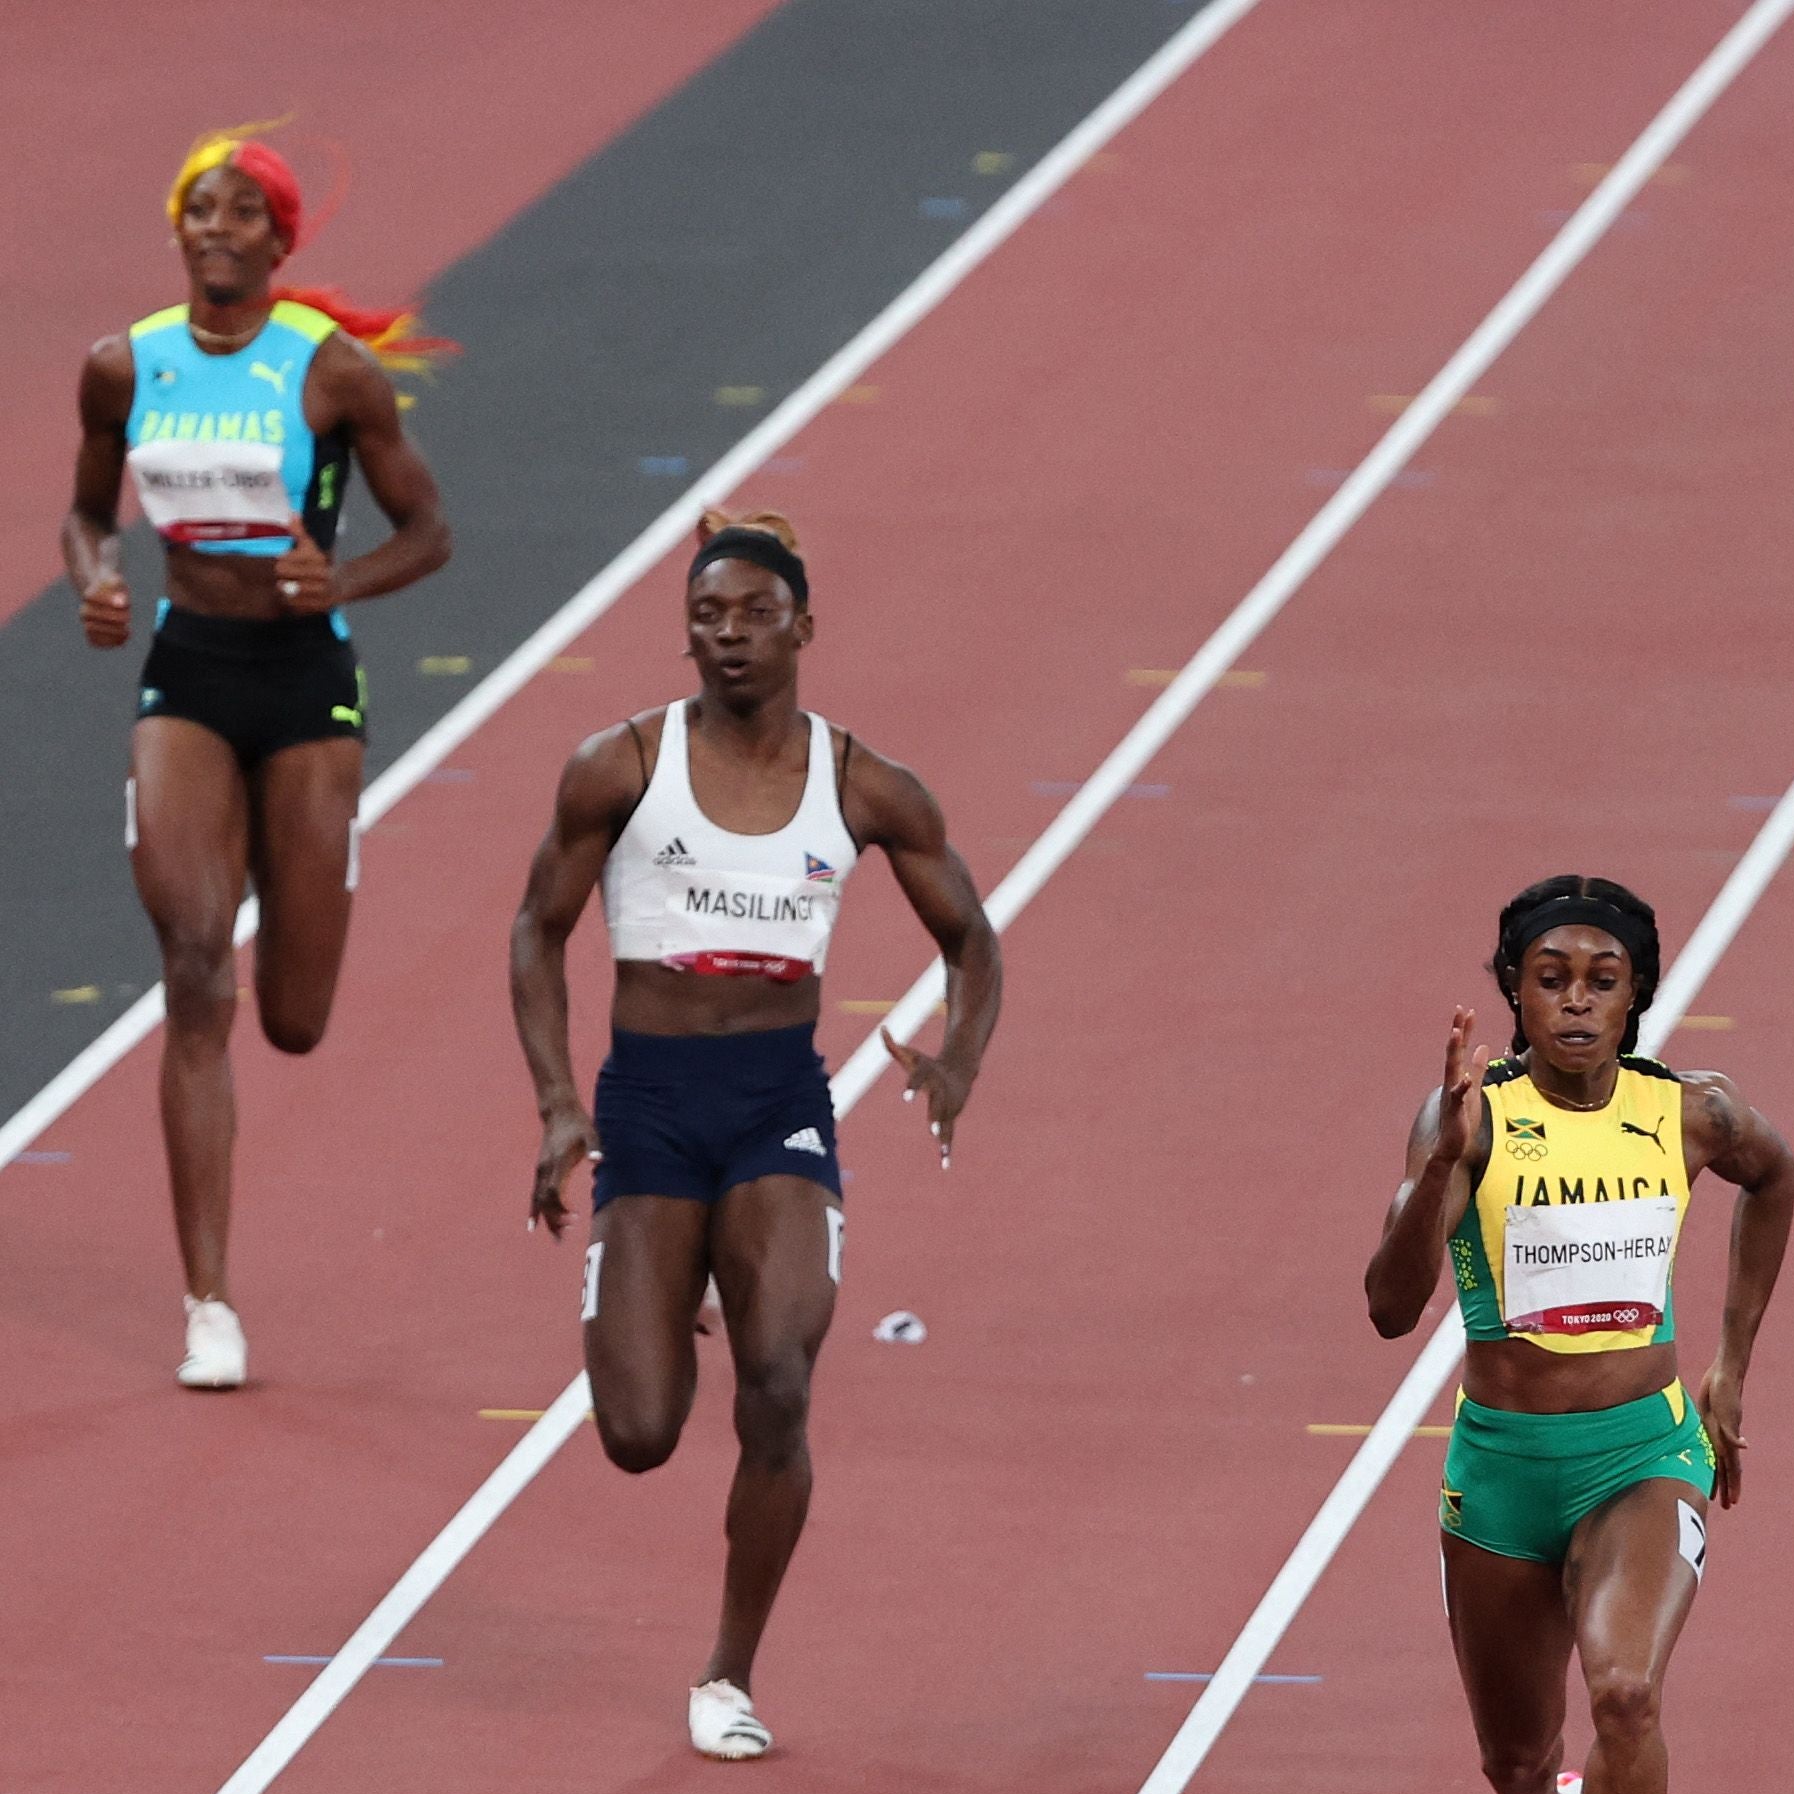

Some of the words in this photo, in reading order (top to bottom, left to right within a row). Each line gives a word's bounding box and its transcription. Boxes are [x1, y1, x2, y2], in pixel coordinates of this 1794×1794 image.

[139, 408, 285, 443] BAHAMAS
[1562, 1314, 1590, 1325] TOKYO
[1591, 1312, 1612, 1323] 2020
